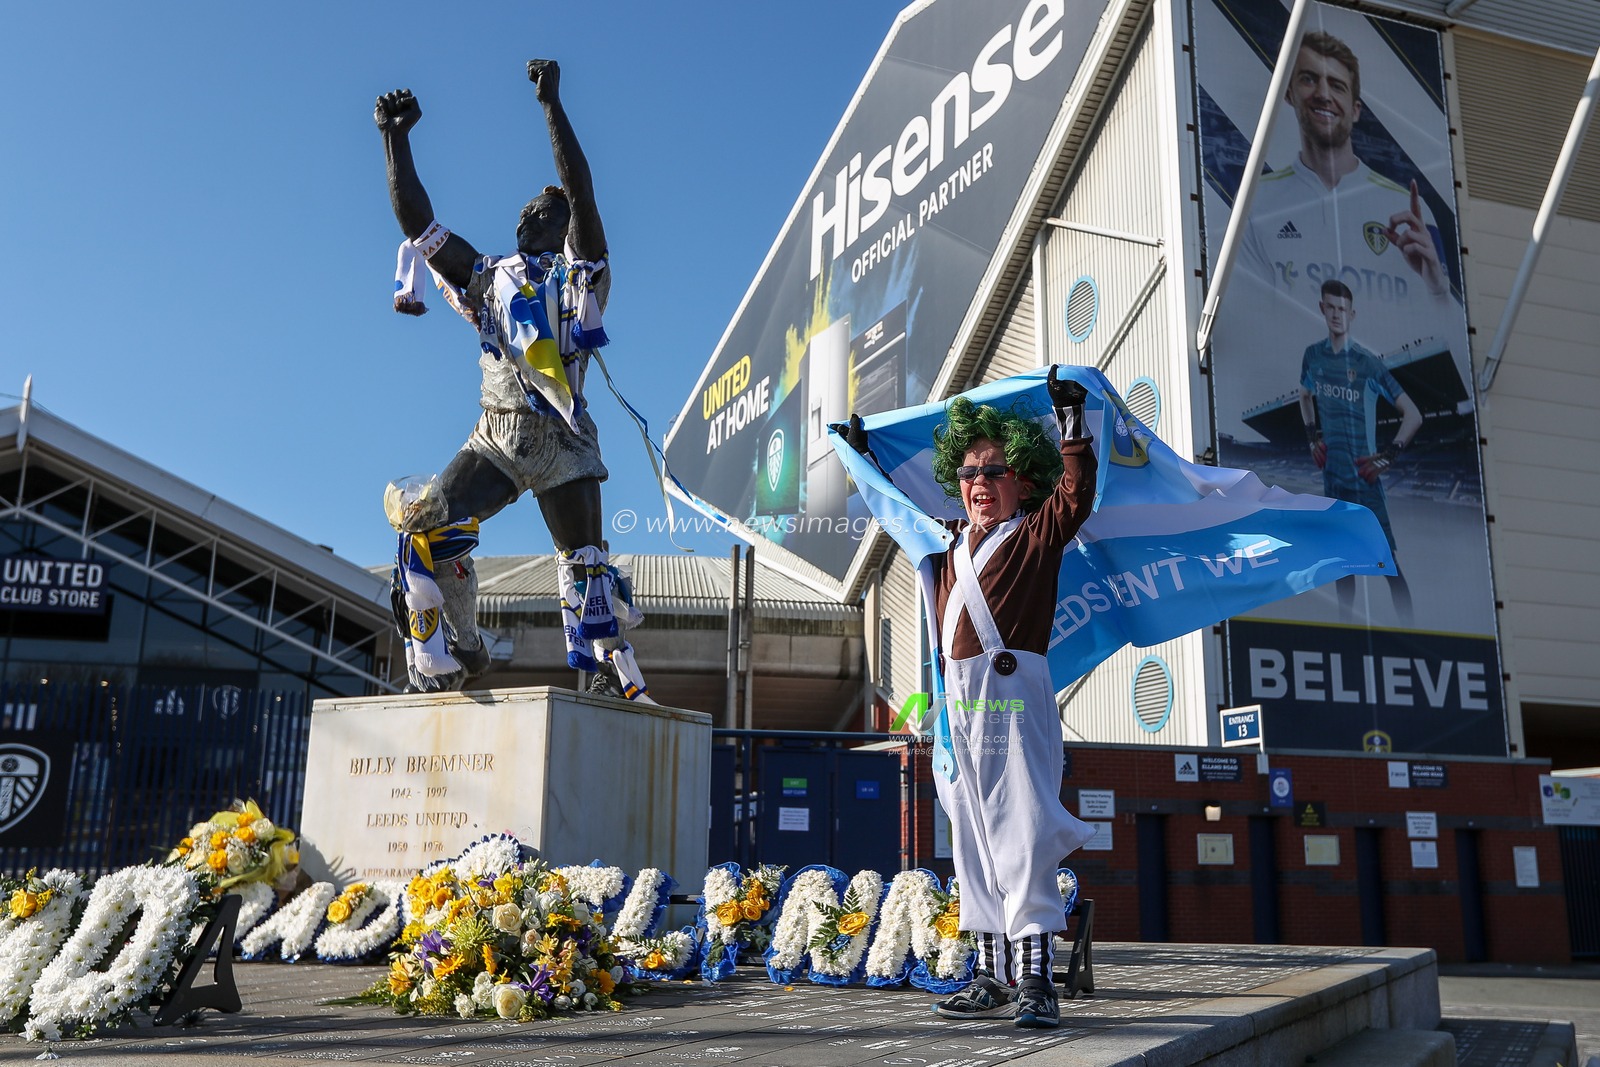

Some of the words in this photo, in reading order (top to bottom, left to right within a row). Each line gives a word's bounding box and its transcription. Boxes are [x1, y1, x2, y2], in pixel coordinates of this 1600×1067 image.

[809, 0, 1065, 281] Hisense
[851, 213, 915, 284] OFFICIAL
[918, 142, 994, 228] PARTNER
[1277, 230, 1302, 239] adidas
[703, 355, 751, 420] UNITED
[1323, 383, 1360, 403] SBOTOP
[706, 411, 725, 455] AT
[726, 375, 770, 440] HOME
[1199, 539, 1280, 579] WE
[3, 558, 104, 588] UNITED
[0, 586, 43, 605] CLUB
[48, 588, 100, 608] STORE
[1249, 647, 1489, 711] BELIEVE
[1228, 713, 1255, 726] ENTRANCE
[1237, 724, 1248, 738] 13
[350, 757, 396, 776] BILLY
[406, 753, 495, 773] BREMNER
[391, 787, 411, 799] 1942
[426, 786, 448, 798] 1997
[366, 813, 409, 828] LEEDS
[416, 811, 468, 827] UNITED
[387, 841, 409, 853] 1959
[423, 841, 444, 852] 1976
